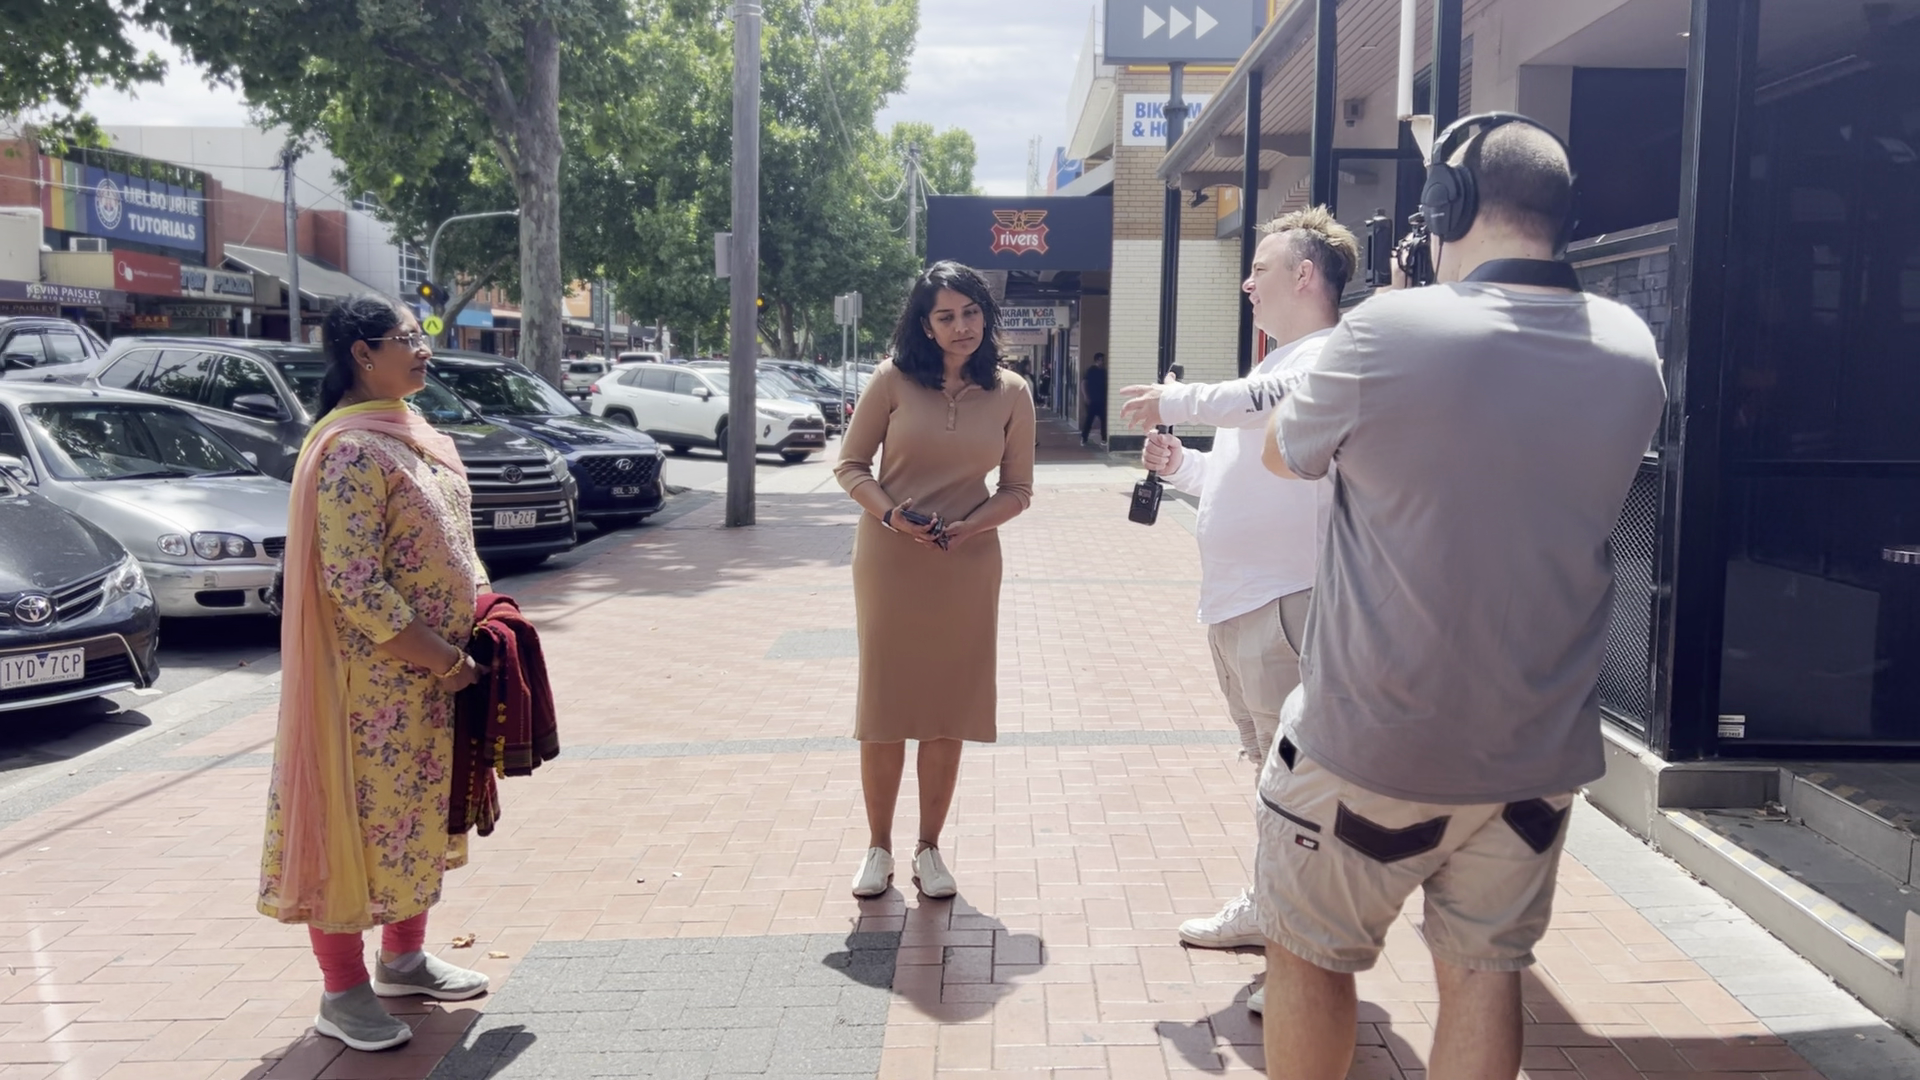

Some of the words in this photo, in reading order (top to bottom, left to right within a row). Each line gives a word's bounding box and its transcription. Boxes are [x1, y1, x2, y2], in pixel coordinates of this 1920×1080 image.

[1135, 102, 1202, 118] BIKM
[1132, 121, 1145, 137] &
[128, 213, 196, 240] TUTORIALS
[1000, 231, 1039, 246] rivers
[26, 284, 58, 295] KEVIN
[61, 287, 101, 299] PAISLEY
[1001, 308, 1030, 317] IKRAM
[1004, 318, 1021, 327] HOT
[1022, 318, 1056, 327] PILATES
